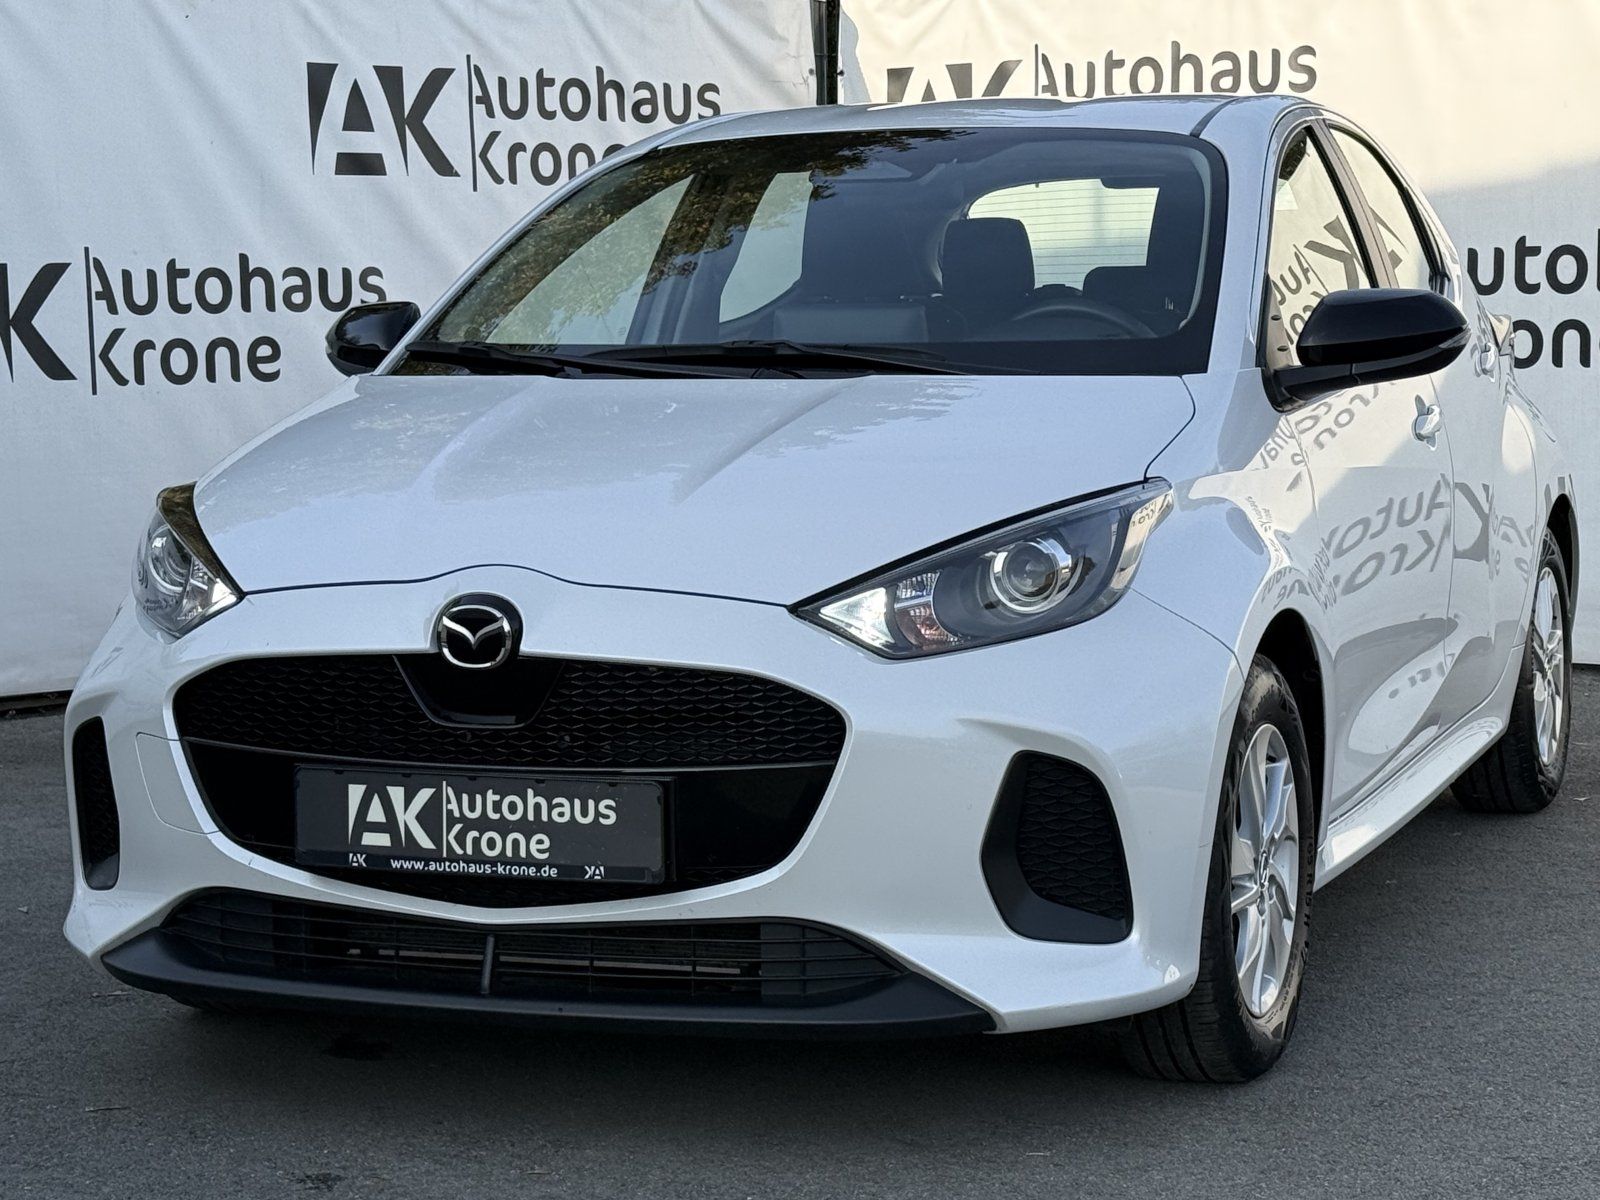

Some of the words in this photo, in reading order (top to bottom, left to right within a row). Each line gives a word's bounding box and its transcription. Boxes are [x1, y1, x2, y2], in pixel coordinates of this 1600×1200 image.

[473, 64, 721, 125] Autohaus
[1041, 40, 1317, 98] Autohaus
[306, 62, 461, 177] AK
[478, 131, 627, 187] Kron
[92, 253, 387, 316] Autohaus
[0, 263, 78, 383] K
[98, 328, 282, 387] Krone
[348, 783, 437, 850] AK
[446, 786, 618, 826] Autohaus
[348, 853, 367, 867] AK
[390, 858, 558, 878] www.autohaus-krone.de
[446, 823, 551, 859] Krone
